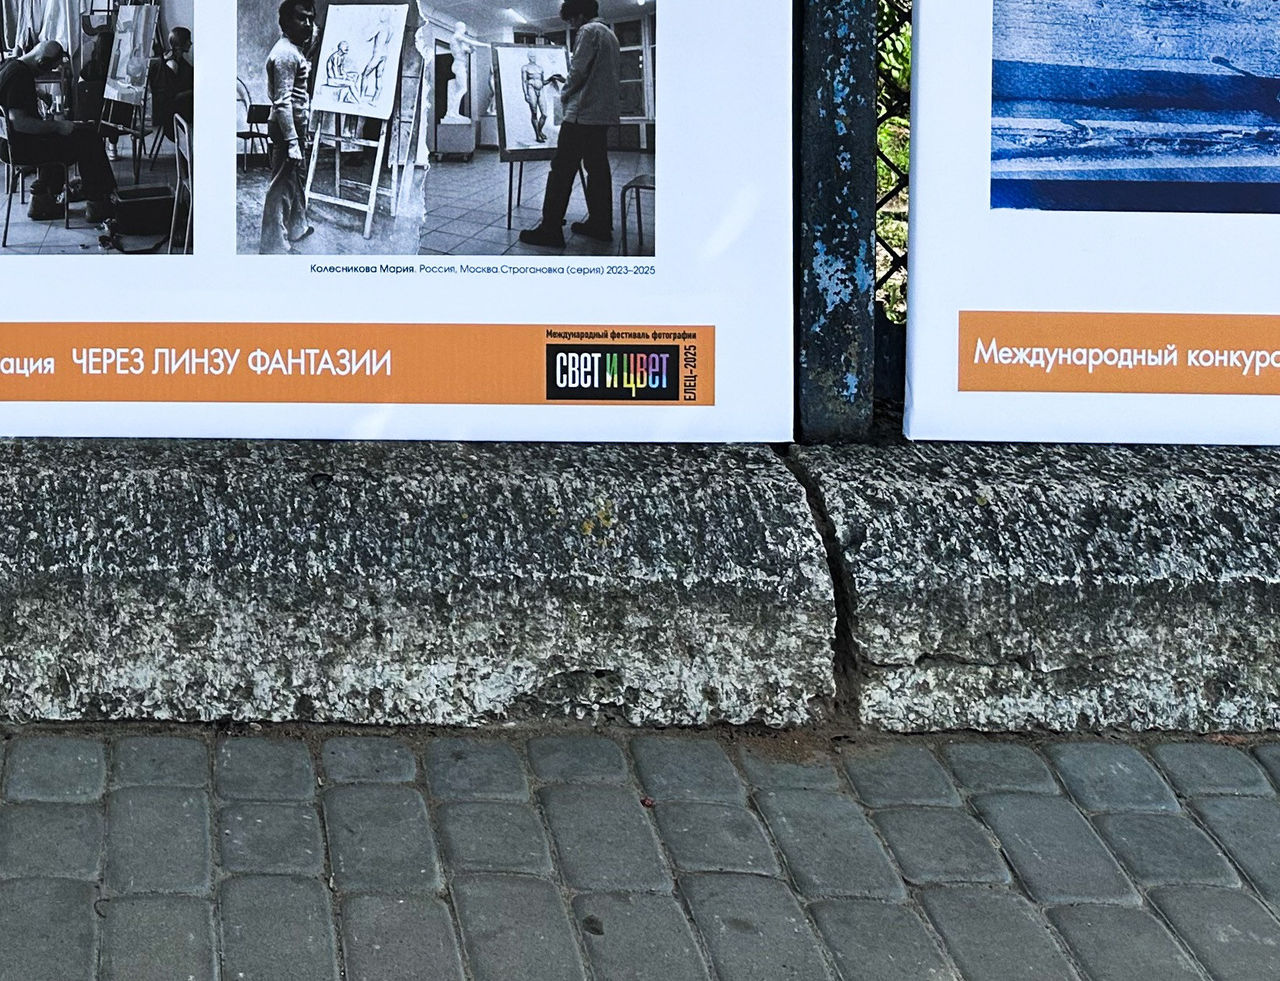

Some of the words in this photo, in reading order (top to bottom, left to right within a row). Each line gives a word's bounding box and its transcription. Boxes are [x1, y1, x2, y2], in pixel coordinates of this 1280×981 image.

[310, 263, 378, 274] Колесникова
[419, 264, 458, 275] Россия,
[566, 265, 605, 276] (серия)
[545, 329, 608, 340] Международный
[610, 329, 650, 340] фестиваль
[651, 330, 697, 341] фотографии
[71, 347, 145, 375] ЧЕРЕЗ
[152, 347, 241, 376] ЛИНЗУ
[247, 347, 392, 376] ФАНТАЗИИ
[973, 337, 1178, 374] Международный
[605, 353, 618, 389] И
